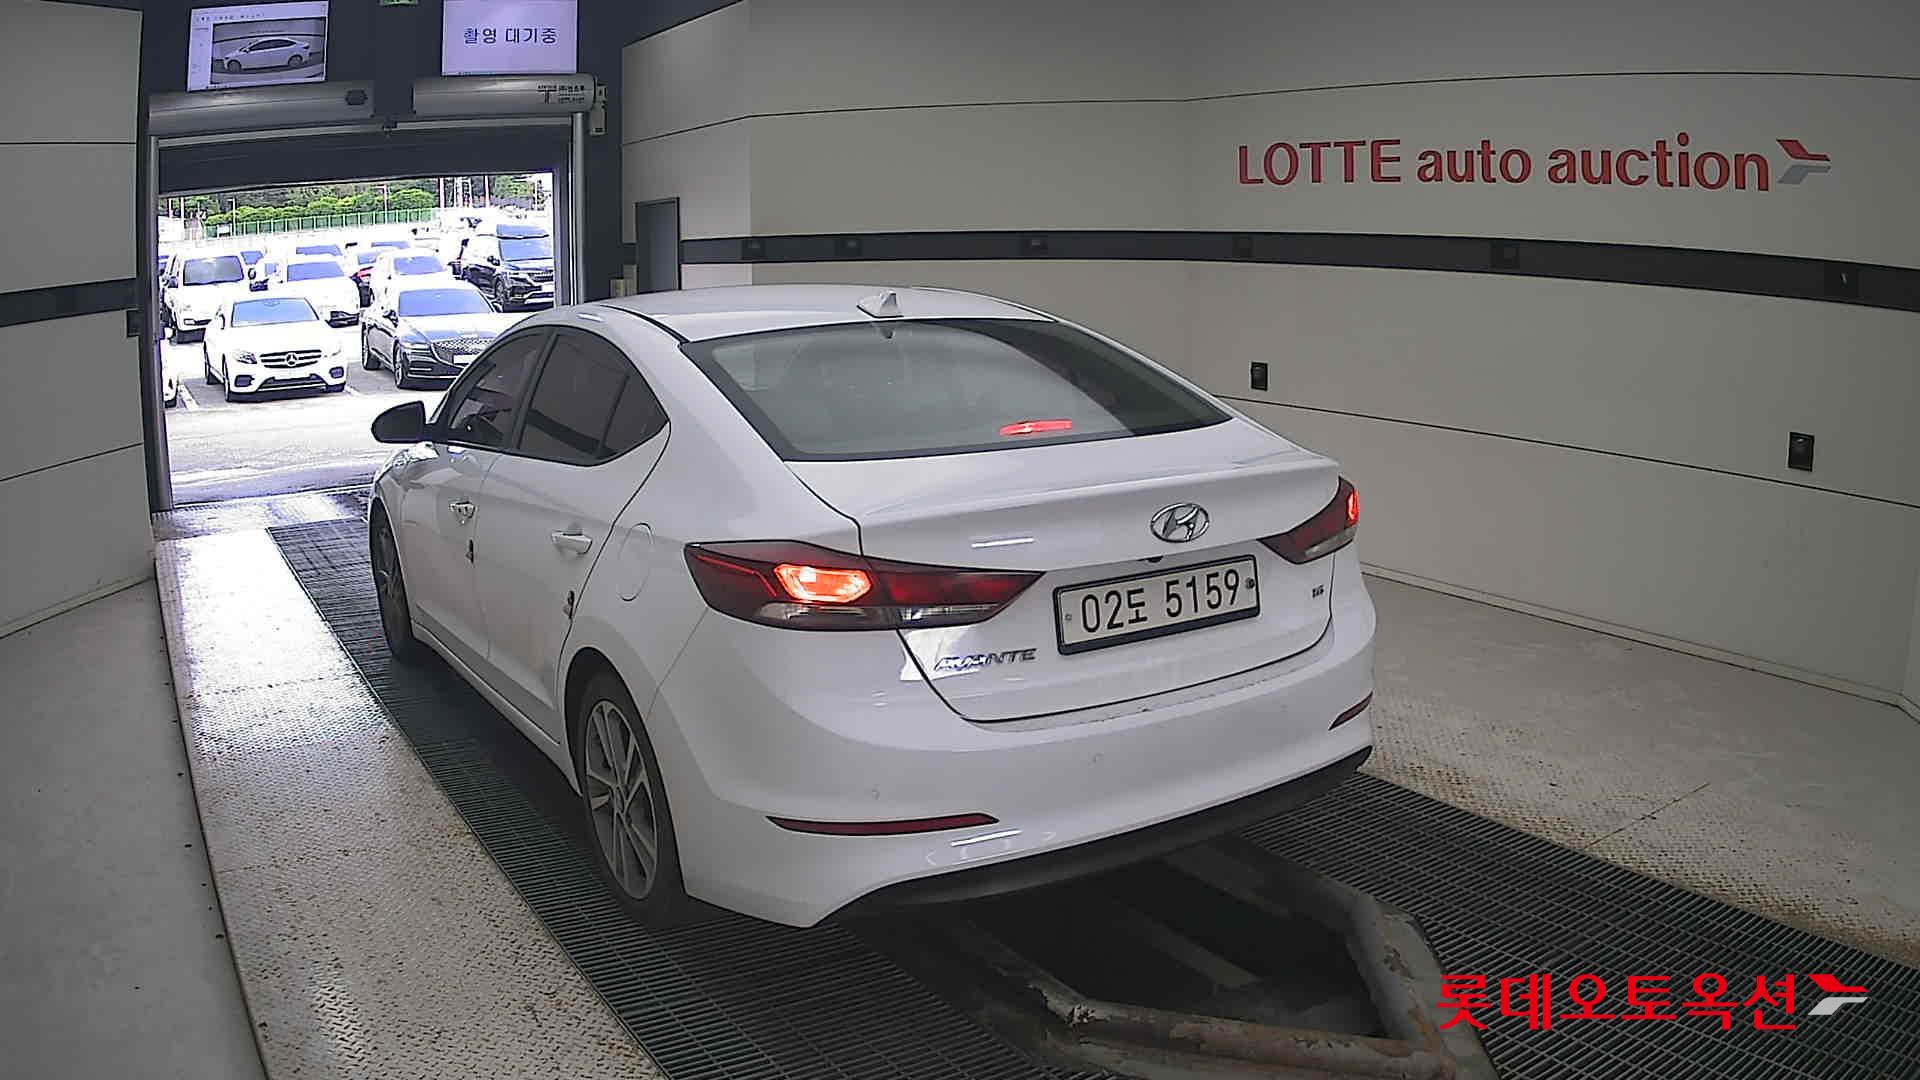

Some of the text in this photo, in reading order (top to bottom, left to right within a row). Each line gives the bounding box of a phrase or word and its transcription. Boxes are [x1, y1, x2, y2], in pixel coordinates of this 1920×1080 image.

[464, 27, 558, 45] 촬영 대기중
[1239, 133, 1770, 192] LOTTE auto auction
[1081, 569, 1240, 633] 02도 5159
[934, 647, 1037, 672] AVANTE
